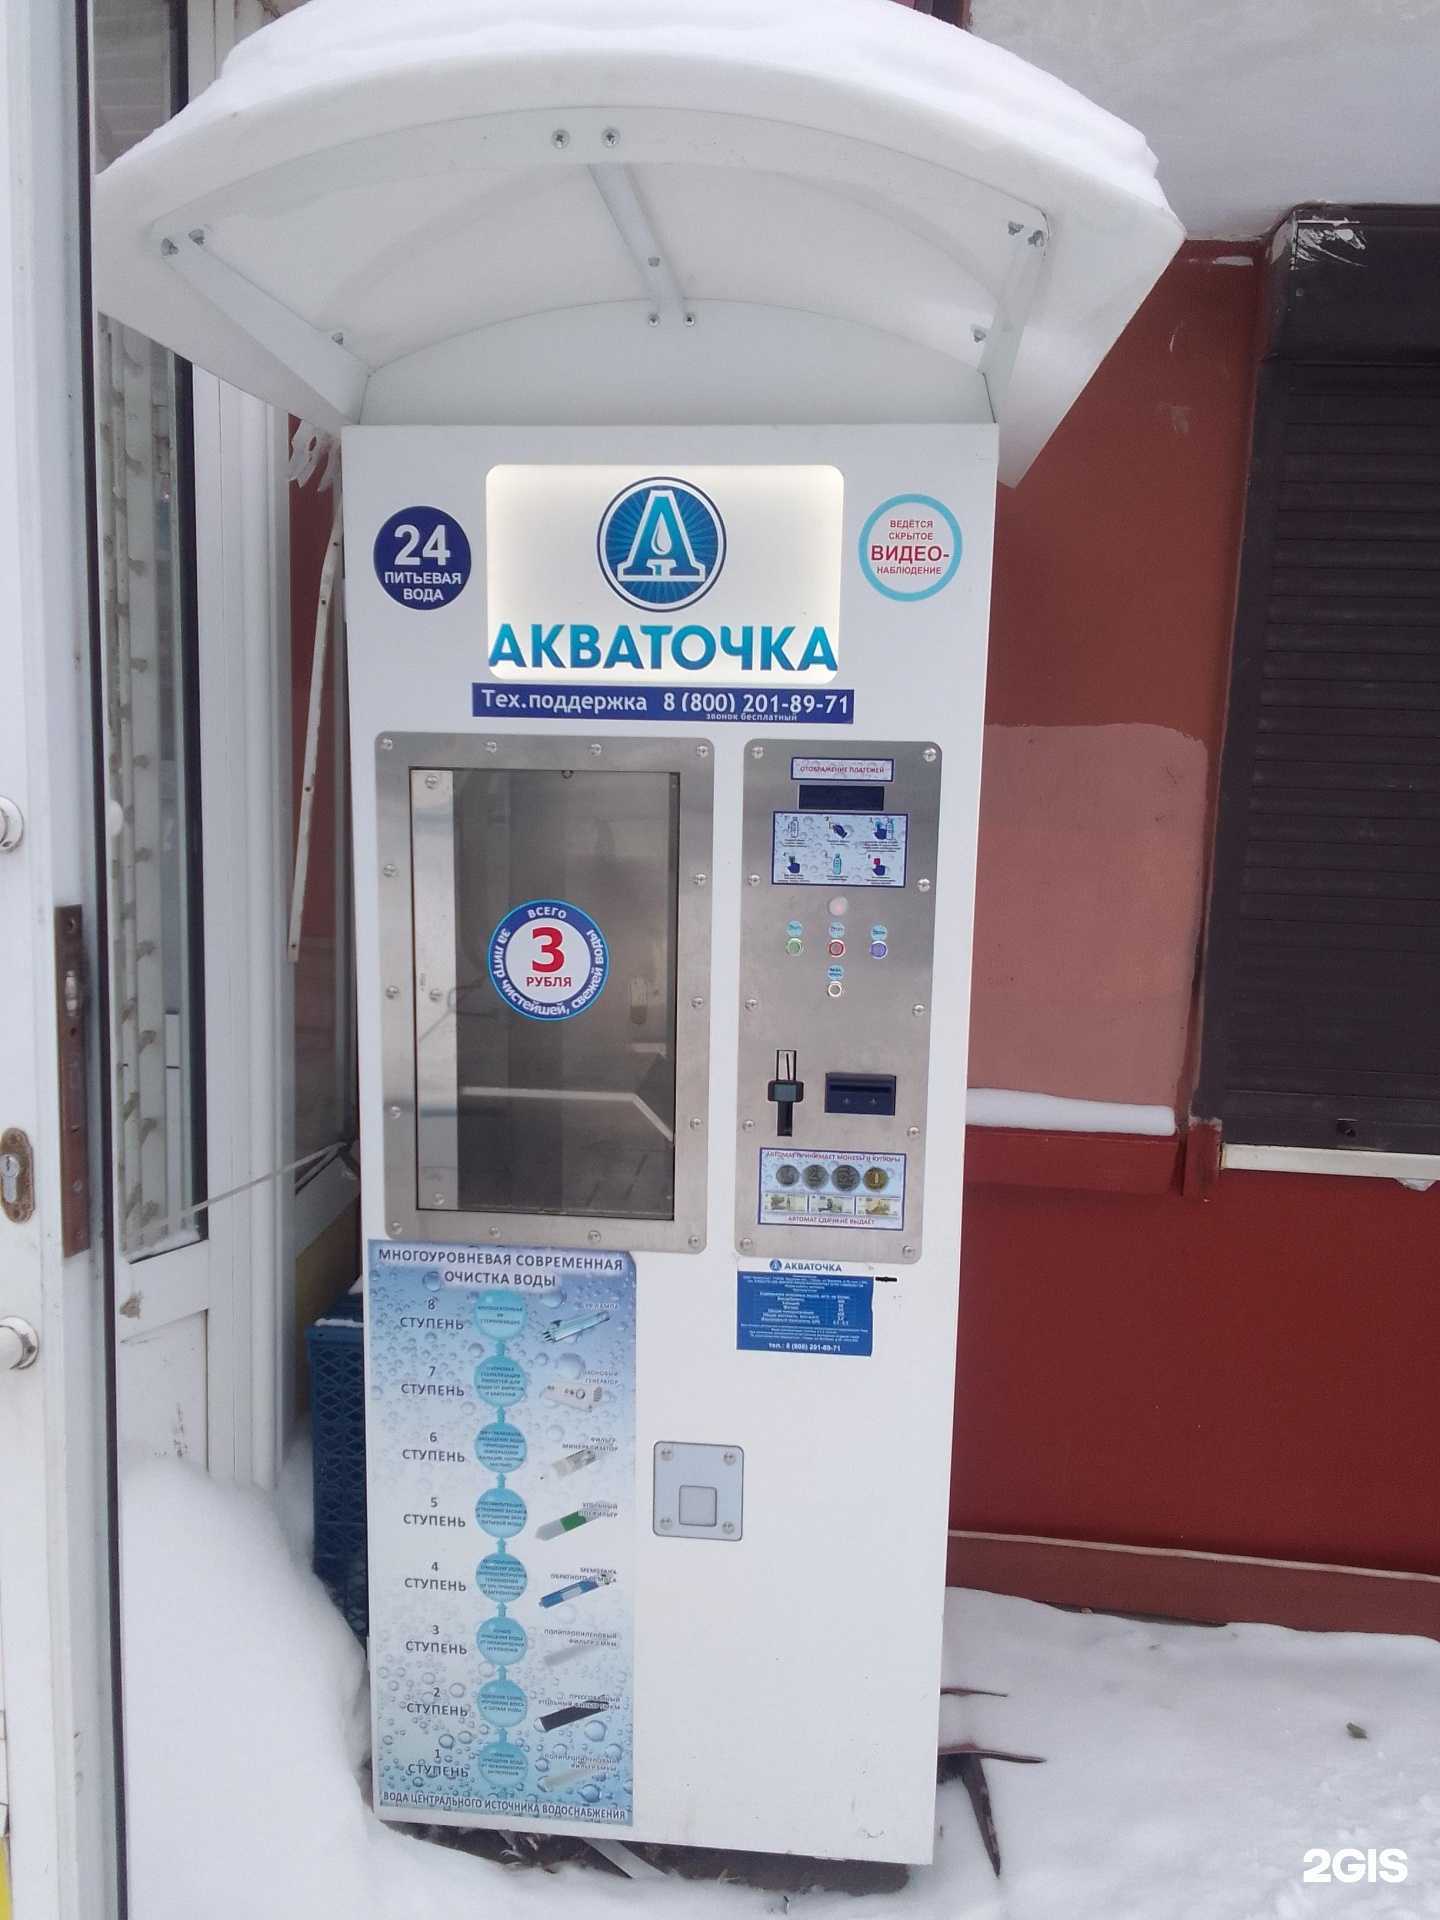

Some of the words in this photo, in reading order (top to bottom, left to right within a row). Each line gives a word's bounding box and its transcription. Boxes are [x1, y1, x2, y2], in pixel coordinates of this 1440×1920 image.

[888, 532, 934, 541] СКРЫТОЕ
[394, 524, 451, 565] 24
[871, 545, 950, 564] ВИДЕО-
[384, 571, 462, 584] ПИТЬЕВАЯ
[876, 566, 942, 576] НАБЛЮДЕНИЕ
[403, 588, 444, 602] ВОДА
[488, 623, 839, 672] АКВАТОЧКА
[481, 688, 648, 713] Тех.поддержка
[663, 693, 676, 710] 8
[682, 693, 736, 714] (800)
[743, 694, 849, 715] 201-89-71
[705, 713, 739, 722] звонок
[740, 712, 798, 723] бесплатный
[527, 906, 567, 919] ВСЕГО
[532, 927, 565, 973] 3
[526, 976, 572, 987] РУБЛЯ
[378, 1249, 512, 1266] МНОГОУРОВНЕВАЯ
[516, 1252, 623, 1271] СОВРЕМЕННАЯ
[784, 1262, 842, 1272] АКВАТОЧКА
[444, 1271, 509, 1284] ОЧИСТКА
[514, 1273, 556, 1288] ВОДЫ
[428, 1299, 436, 1310] 8
[400, 1316, 465, 1330] СТУПЕНЬ
[429, 1366, 436, 1377] 7
[401, 1383, 465, 1397] СТУПЕНЬ
[429, 1431, 437, 1443] 6
[402, 1449, 466, 1463] СТУПЕНЬ
[431, 1496, 438, 1508] 5
[403, 1514, 466, 1528] СТУПЕНЬ
[431, 1561, 439, 1572] 4
[404, 1577, 467, 1592] СТУПЕНЬ
[432, 1624, 440, 1635] 3
[405, 1641, 468, 1655] СТУПЕНЬ
[433, 1687, 441, 1698] 2
[406, 1702, 468, 1717] СТУПЕНЬ
[434, 1749, 441, 1759] 1
[408, 1763, 469, 1778] СТУПЕНЬ
[383, 1791, 410, 1803] ВОДА
[411, 1793, 482, 1809] ЦЕНТРАЛЬНОГО
[484, 1799, 540, 1814] ИСТОЧНИКА
[542, 1804, 626, 1819] ВОДОСНАБЖЕНИЯ
